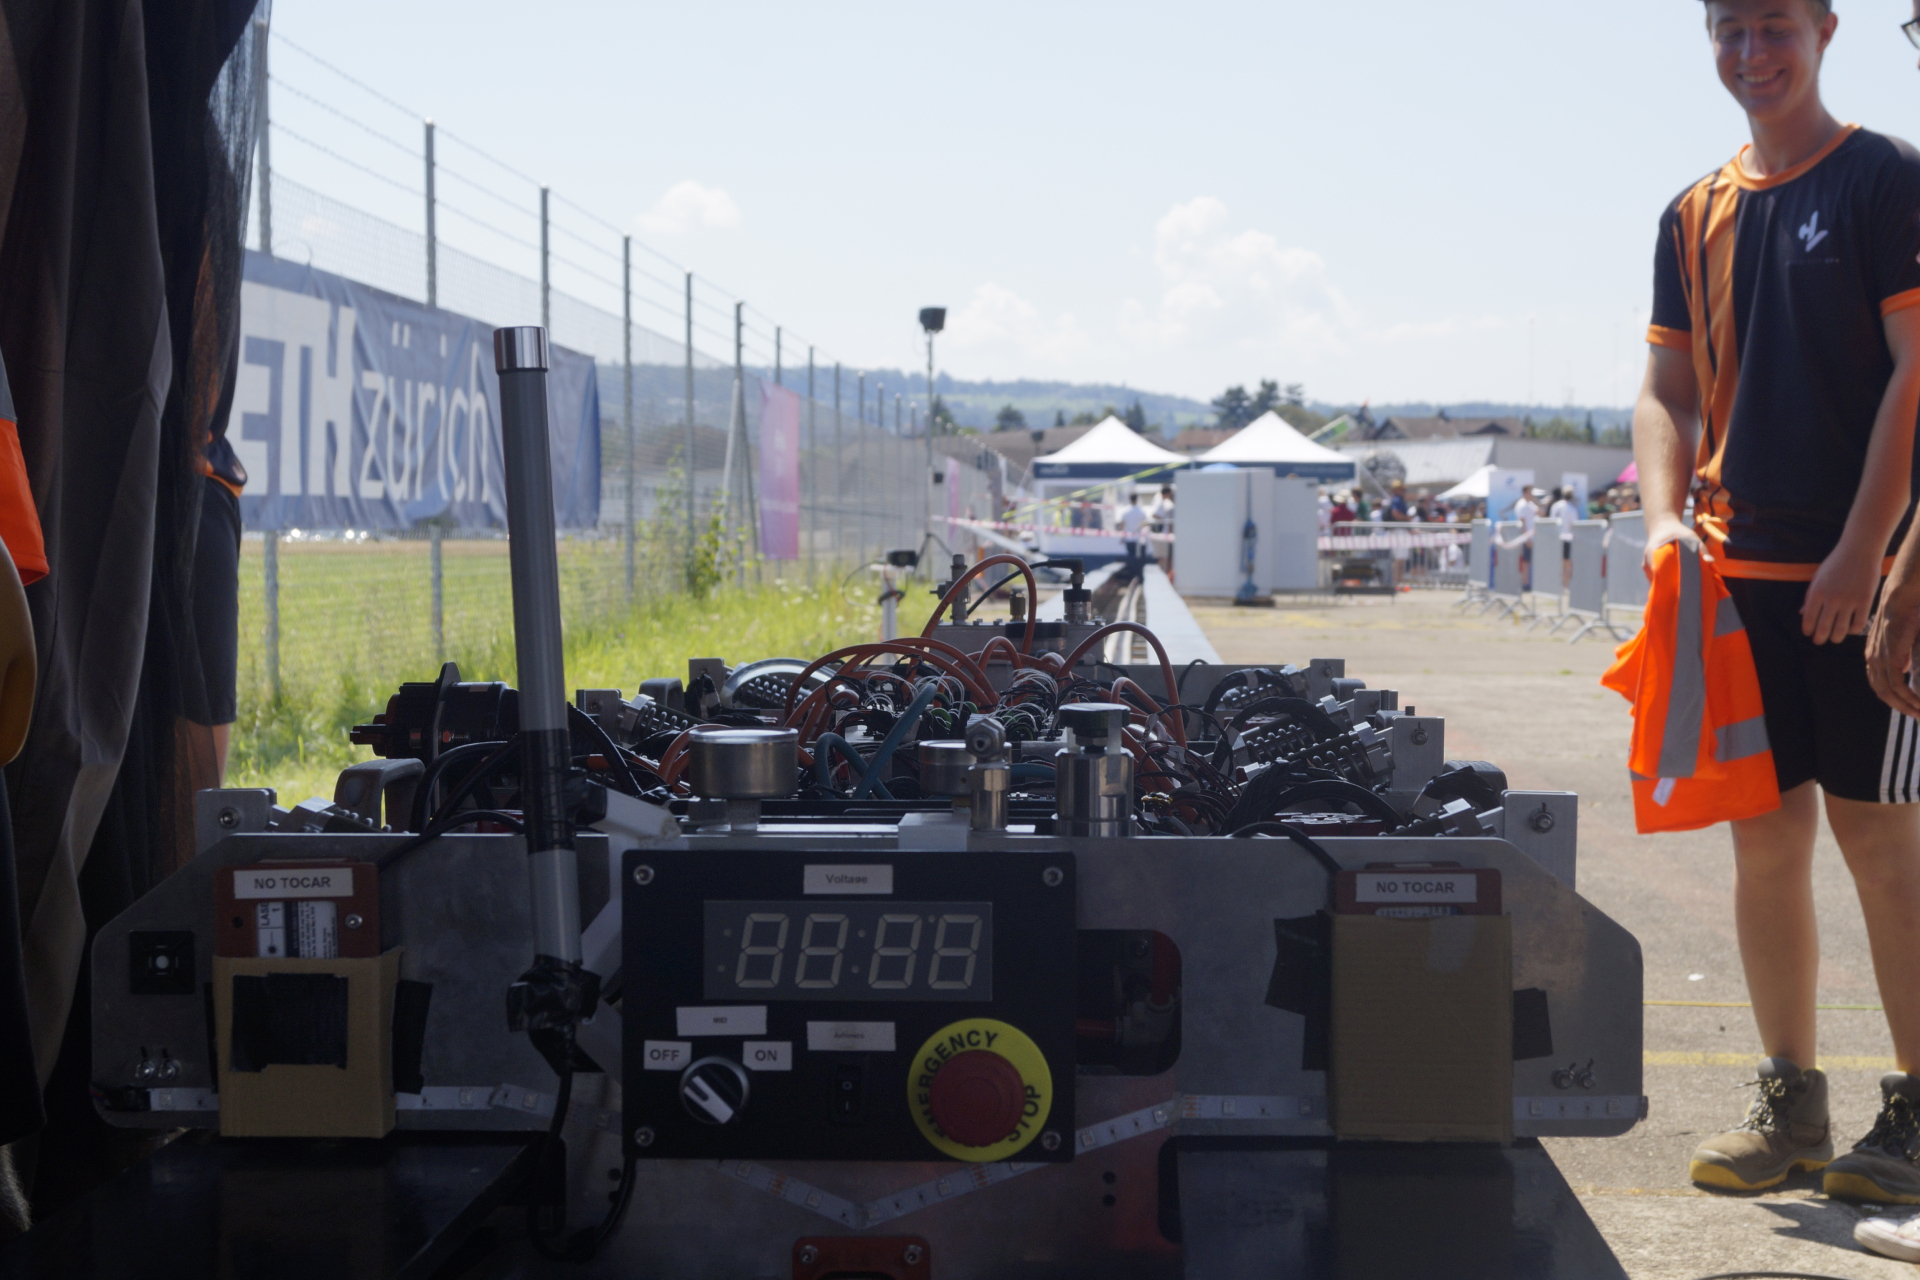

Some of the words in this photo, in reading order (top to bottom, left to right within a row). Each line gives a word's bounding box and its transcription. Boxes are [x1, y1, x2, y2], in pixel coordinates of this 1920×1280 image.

[254, 877, 276, 889] NO
[280, 876, 331, 888] TOCAR
[1376, 881, 1398, 893] NO
[1403, 881, 1455, 893] TOCAR
[649, 1048, 680, 1062] OFF
[754, 1048, 778, 1062] ON
